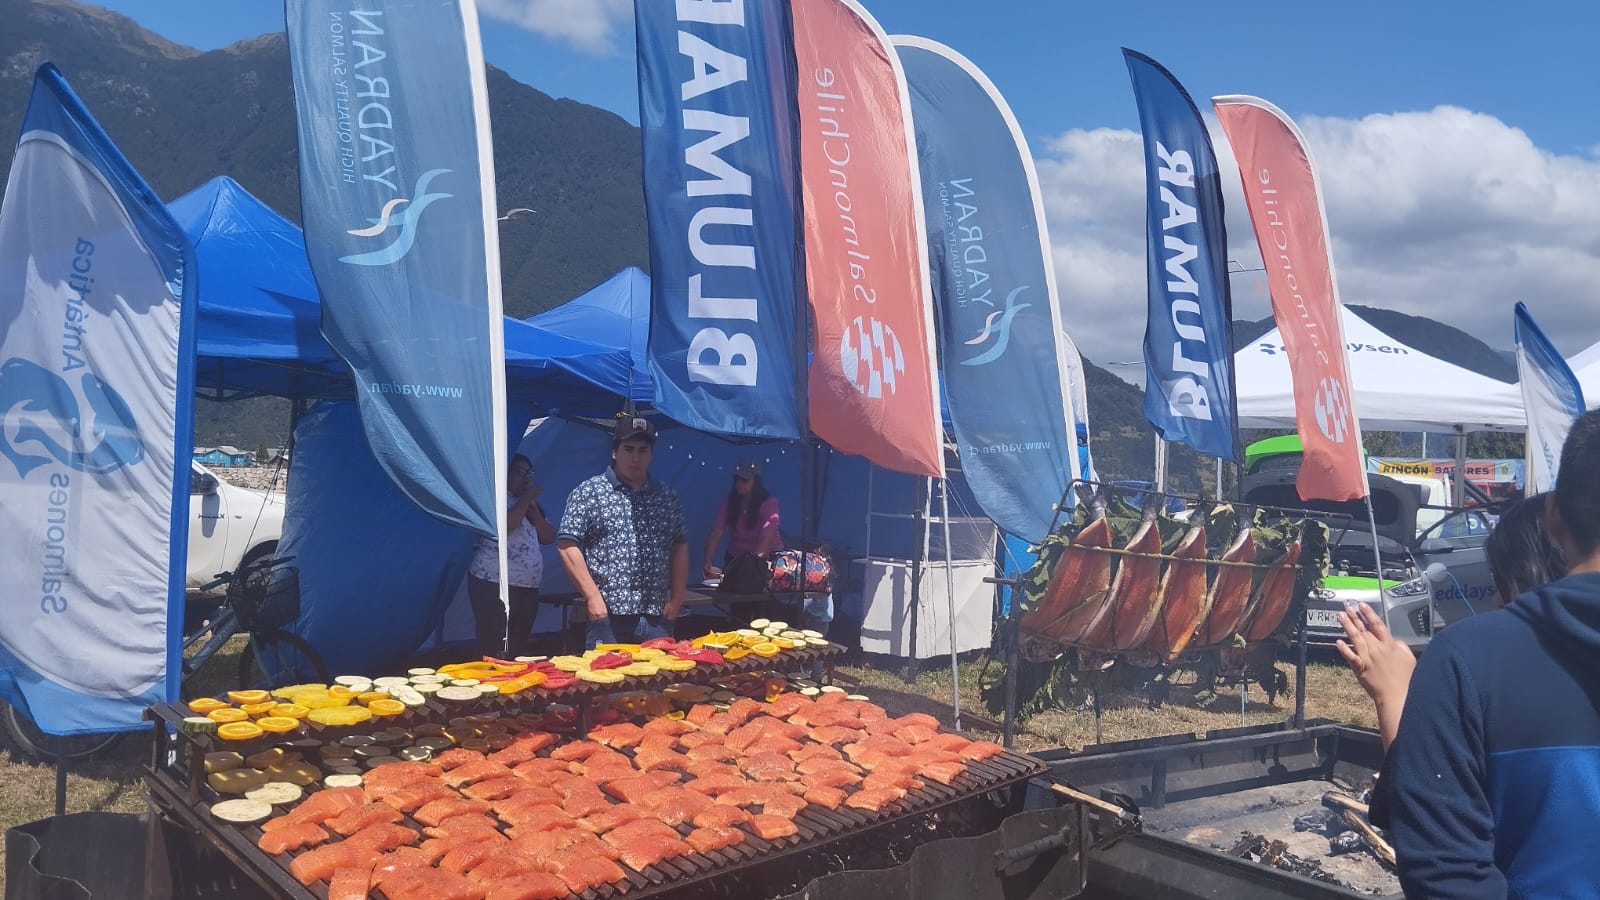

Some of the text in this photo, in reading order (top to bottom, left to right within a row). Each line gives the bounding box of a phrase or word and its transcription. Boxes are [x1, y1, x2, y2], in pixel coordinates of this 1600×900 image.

[1383, 464, 1490, 475] RINCÓN SARES
[1435, 584, 1496, 601] edelays
